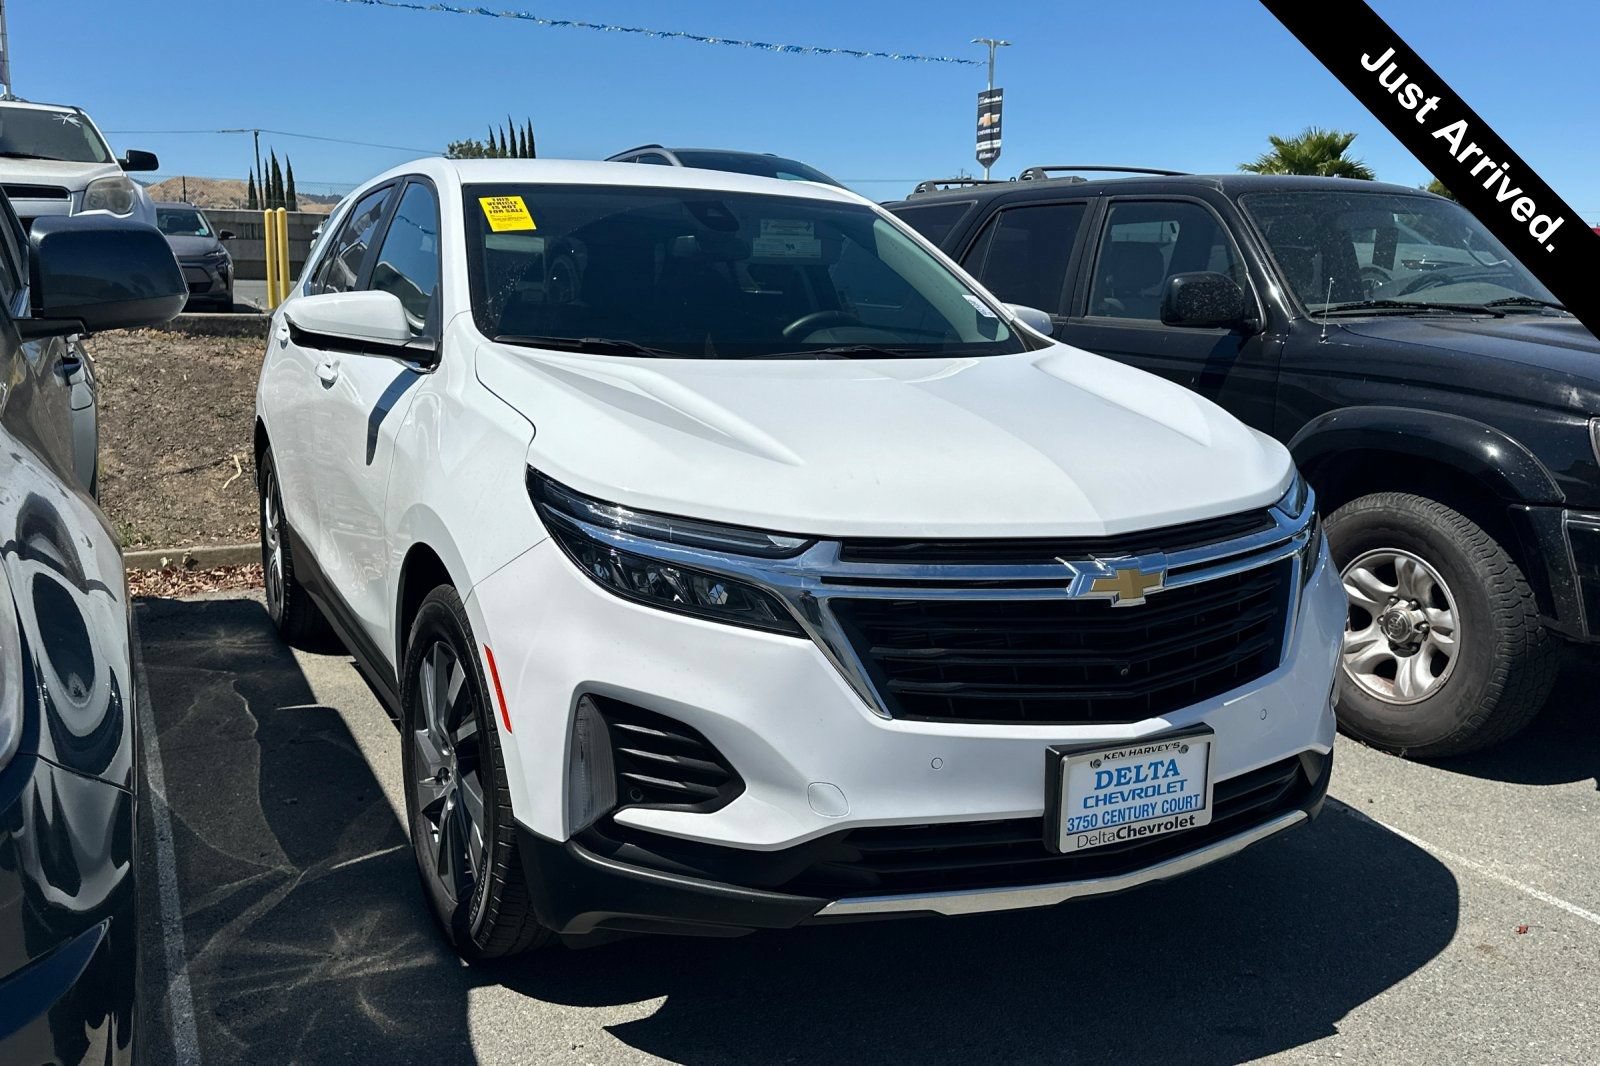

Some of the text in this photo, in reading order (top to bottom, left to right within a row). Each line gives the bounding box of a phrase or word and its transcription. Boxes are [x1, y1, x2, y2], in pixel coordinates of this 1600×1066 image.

[1103, 742, 1181, 761] KEN HARVEY'S
[1094, 758, 1180, 790] DELTA
[1083, 779, 1188, 809] CHEVROLET
[1067, 794, 1200, 832] 3750 CENTURY COURT
